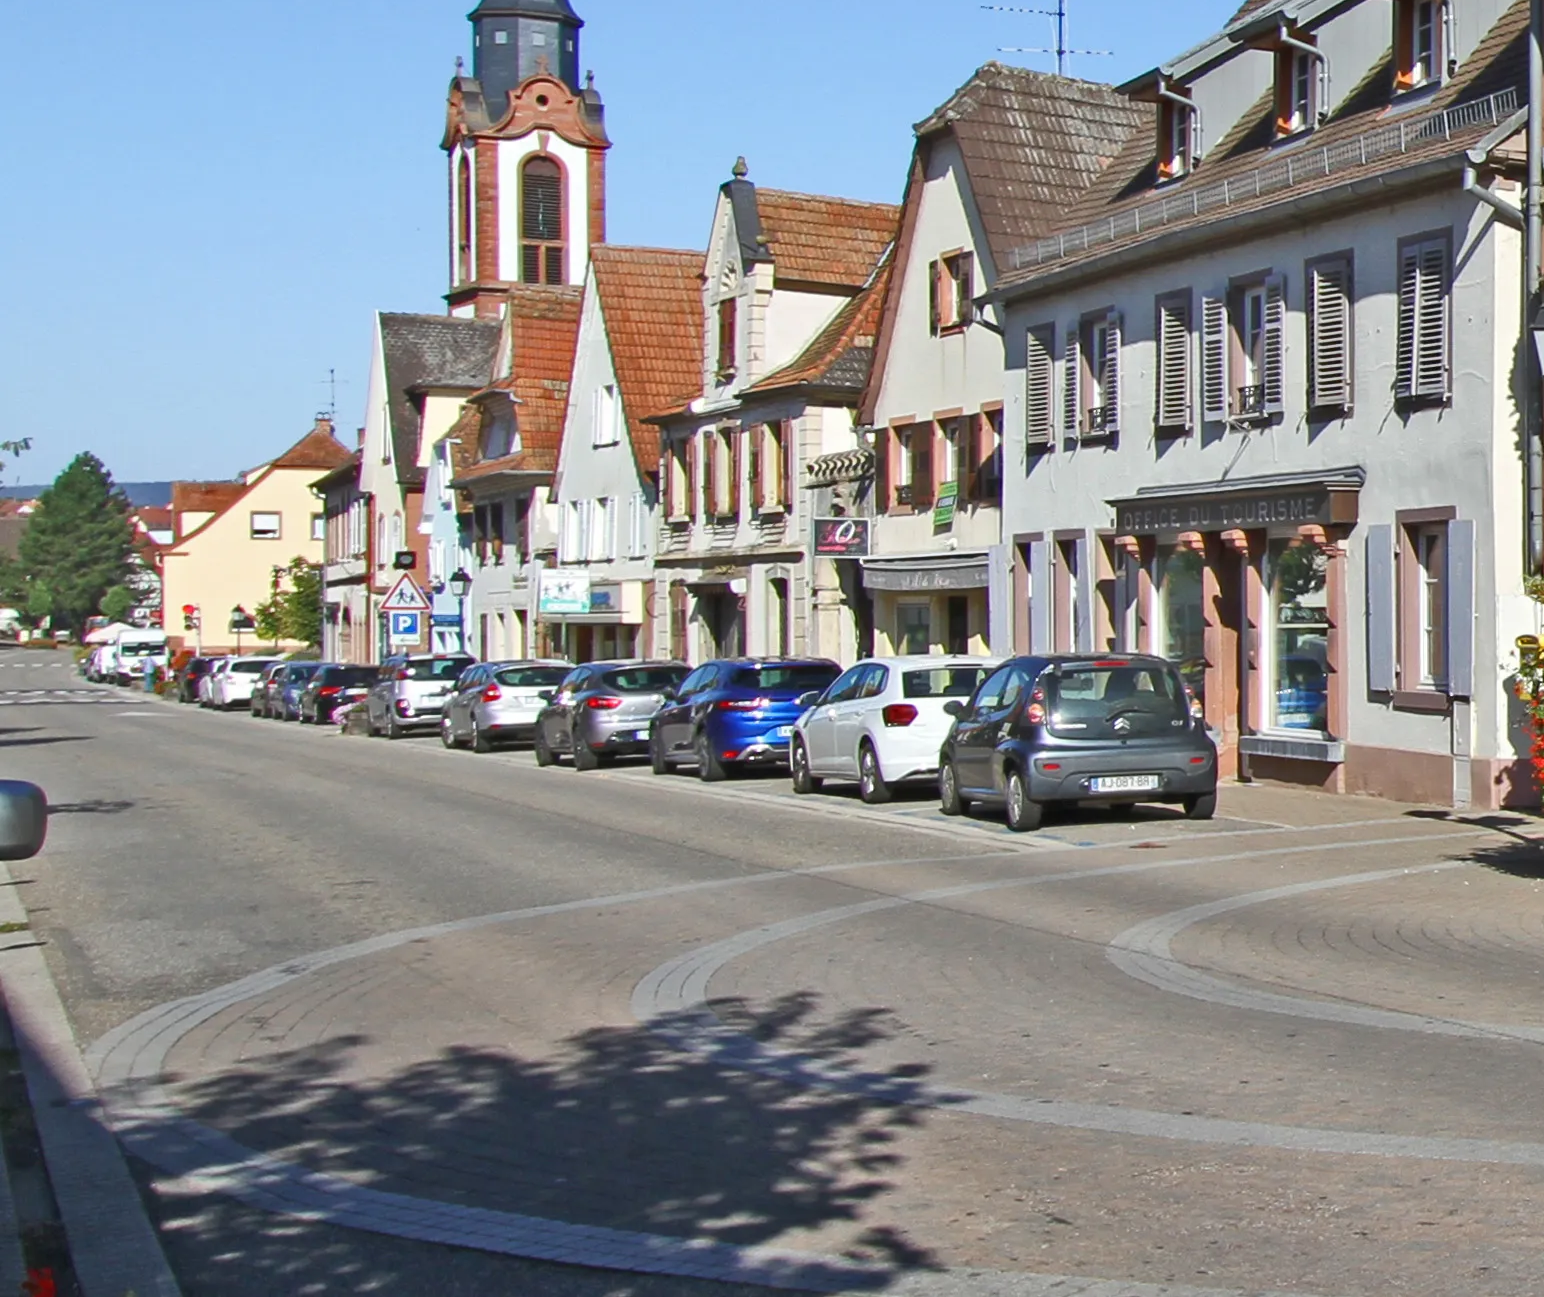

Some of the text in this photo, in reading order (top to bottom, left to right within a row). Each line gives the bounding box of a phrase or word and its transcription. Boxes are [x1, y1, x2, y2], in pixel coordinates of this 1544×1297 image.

[1124, 498, 1317, 530] OFFICE DU TOURISME
[398, 615, 412, 632] P
